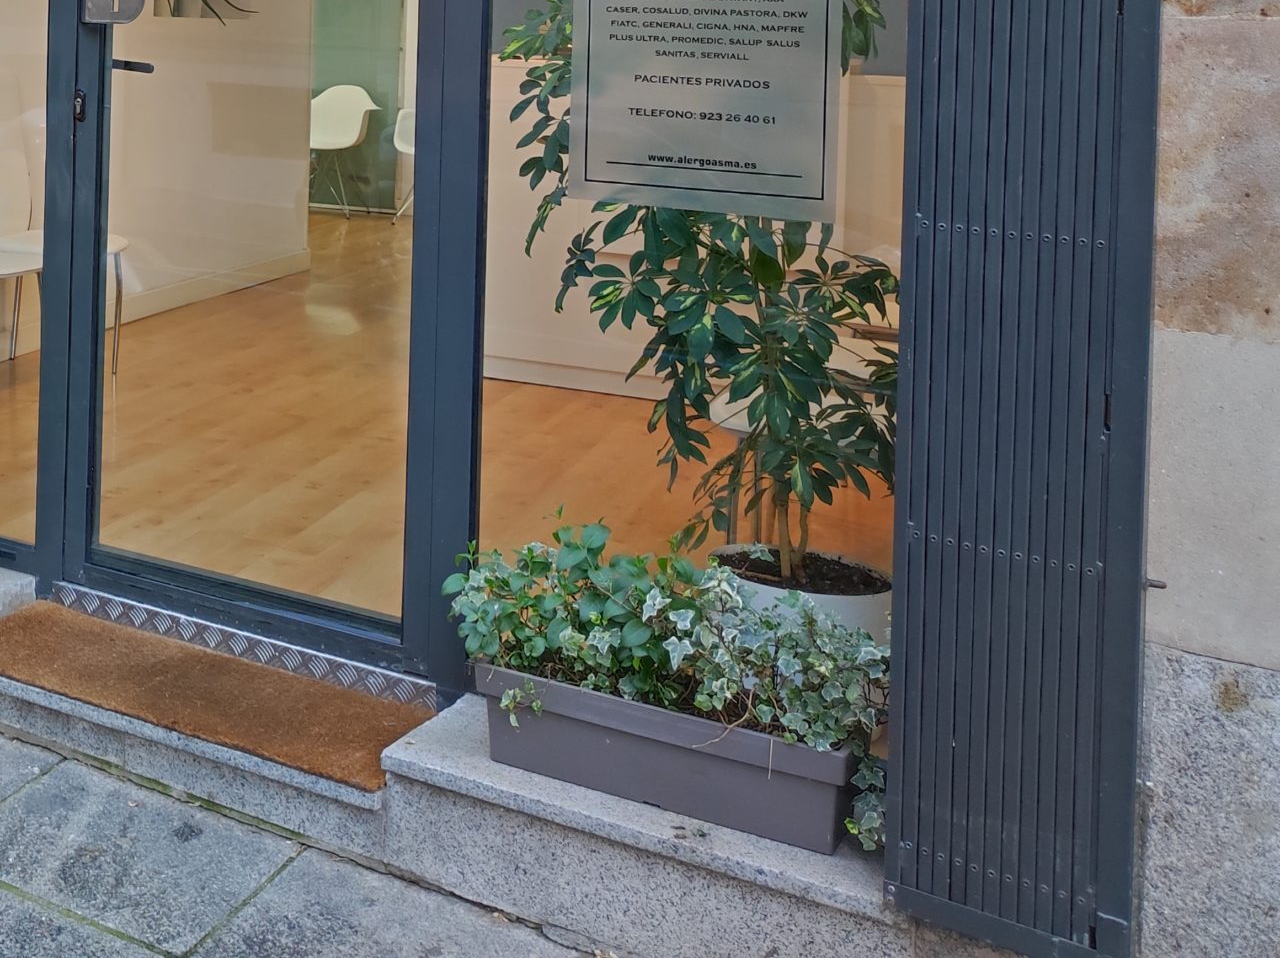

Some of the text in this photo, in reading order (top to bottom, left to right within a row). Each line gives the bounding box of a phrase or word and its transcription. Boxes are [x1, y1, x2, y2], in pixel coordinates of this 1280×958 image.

[606, 6, 640, 14] CASER,
[643, 7, 691, 16] COSALUD,
[730, 10, 780, 18] PASTORA,
[643, 22, 694, 30] GENERALI,
[761, 25, 805, 33] MAPFRE
[767, 40, 800, 48] SALUS
[700, 52, 749, 60] SERVIALL
[634, 74, 770, 89] PACIENTES PRIVADOS
[628, 107, 775, 124] TELEFONO: 923 26 40 61
[648, 154, 757, 169] www.alergoasma.es
